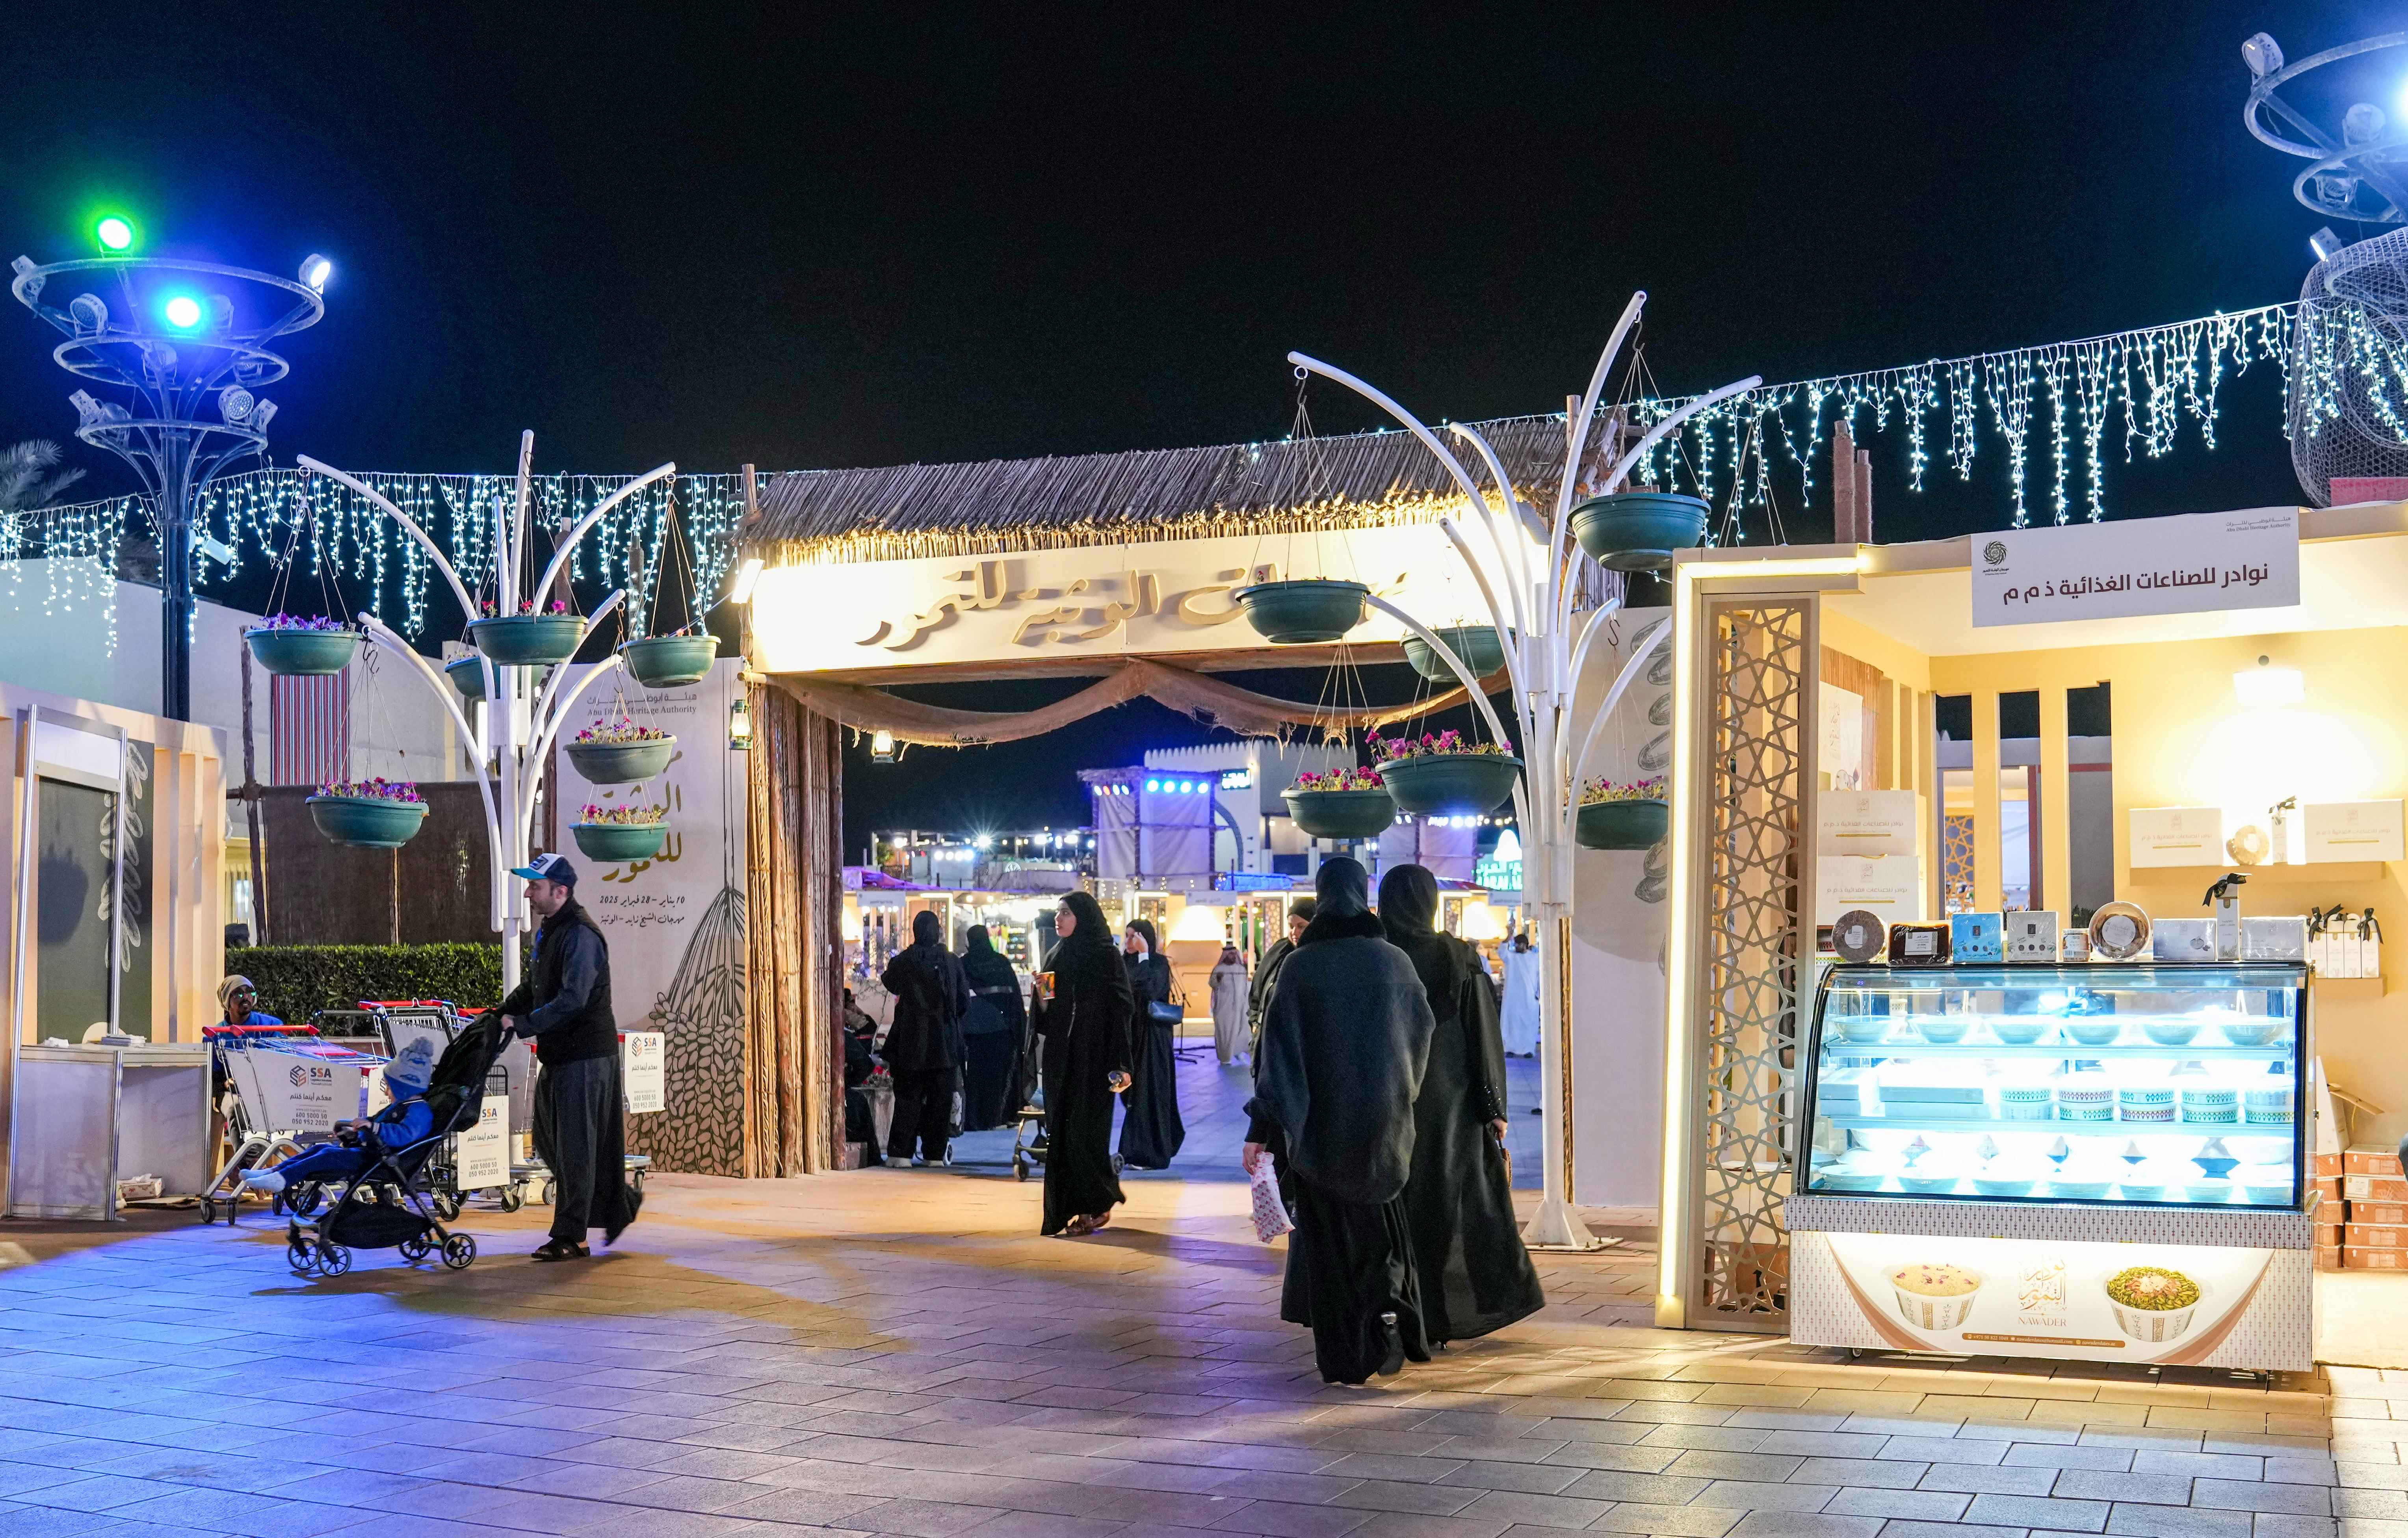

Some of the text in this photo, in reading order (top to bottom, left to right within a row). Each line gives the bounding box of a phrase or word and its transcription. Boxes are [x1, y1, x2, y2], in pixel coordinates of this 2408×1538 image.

[2003, 563, 2268, 605] نوادر للصناعات الغذائية ذ م م
[854, 560, 1006, 651] للتمور
[1012, 569, 1160, 644] الوثبة
[605, 707, 625, 715] Dhab
[628, 706, 659, 716] Heritage
[661, 705, 697, 714] Authority
[602, 832, 682, 883] للمور
[600, 895, 619, 904] 2025
[620, 895, 639, 908] فبراير
[641, 895, 650, 904] 28
[659, 895, 675, 908] يناير
[676, 896, 685, 904] 10
[600, 914, 617, 925] الوثبة
[625, 915, 639, 926] زايد
[640, 912, 656, 927] الشيخ
[658, 914, 685, 925] مهرجان
[644, 1037, 656, 1046] SSA
[310, 1067, 331, 1078] SSA
[303, 1092, 314, 1101] أينما
[482, 1108, 497, 1118] SSA
[478, 1132, 486, 1141] أينما
[2018, 1316, 2067, 1327] NAWADER
